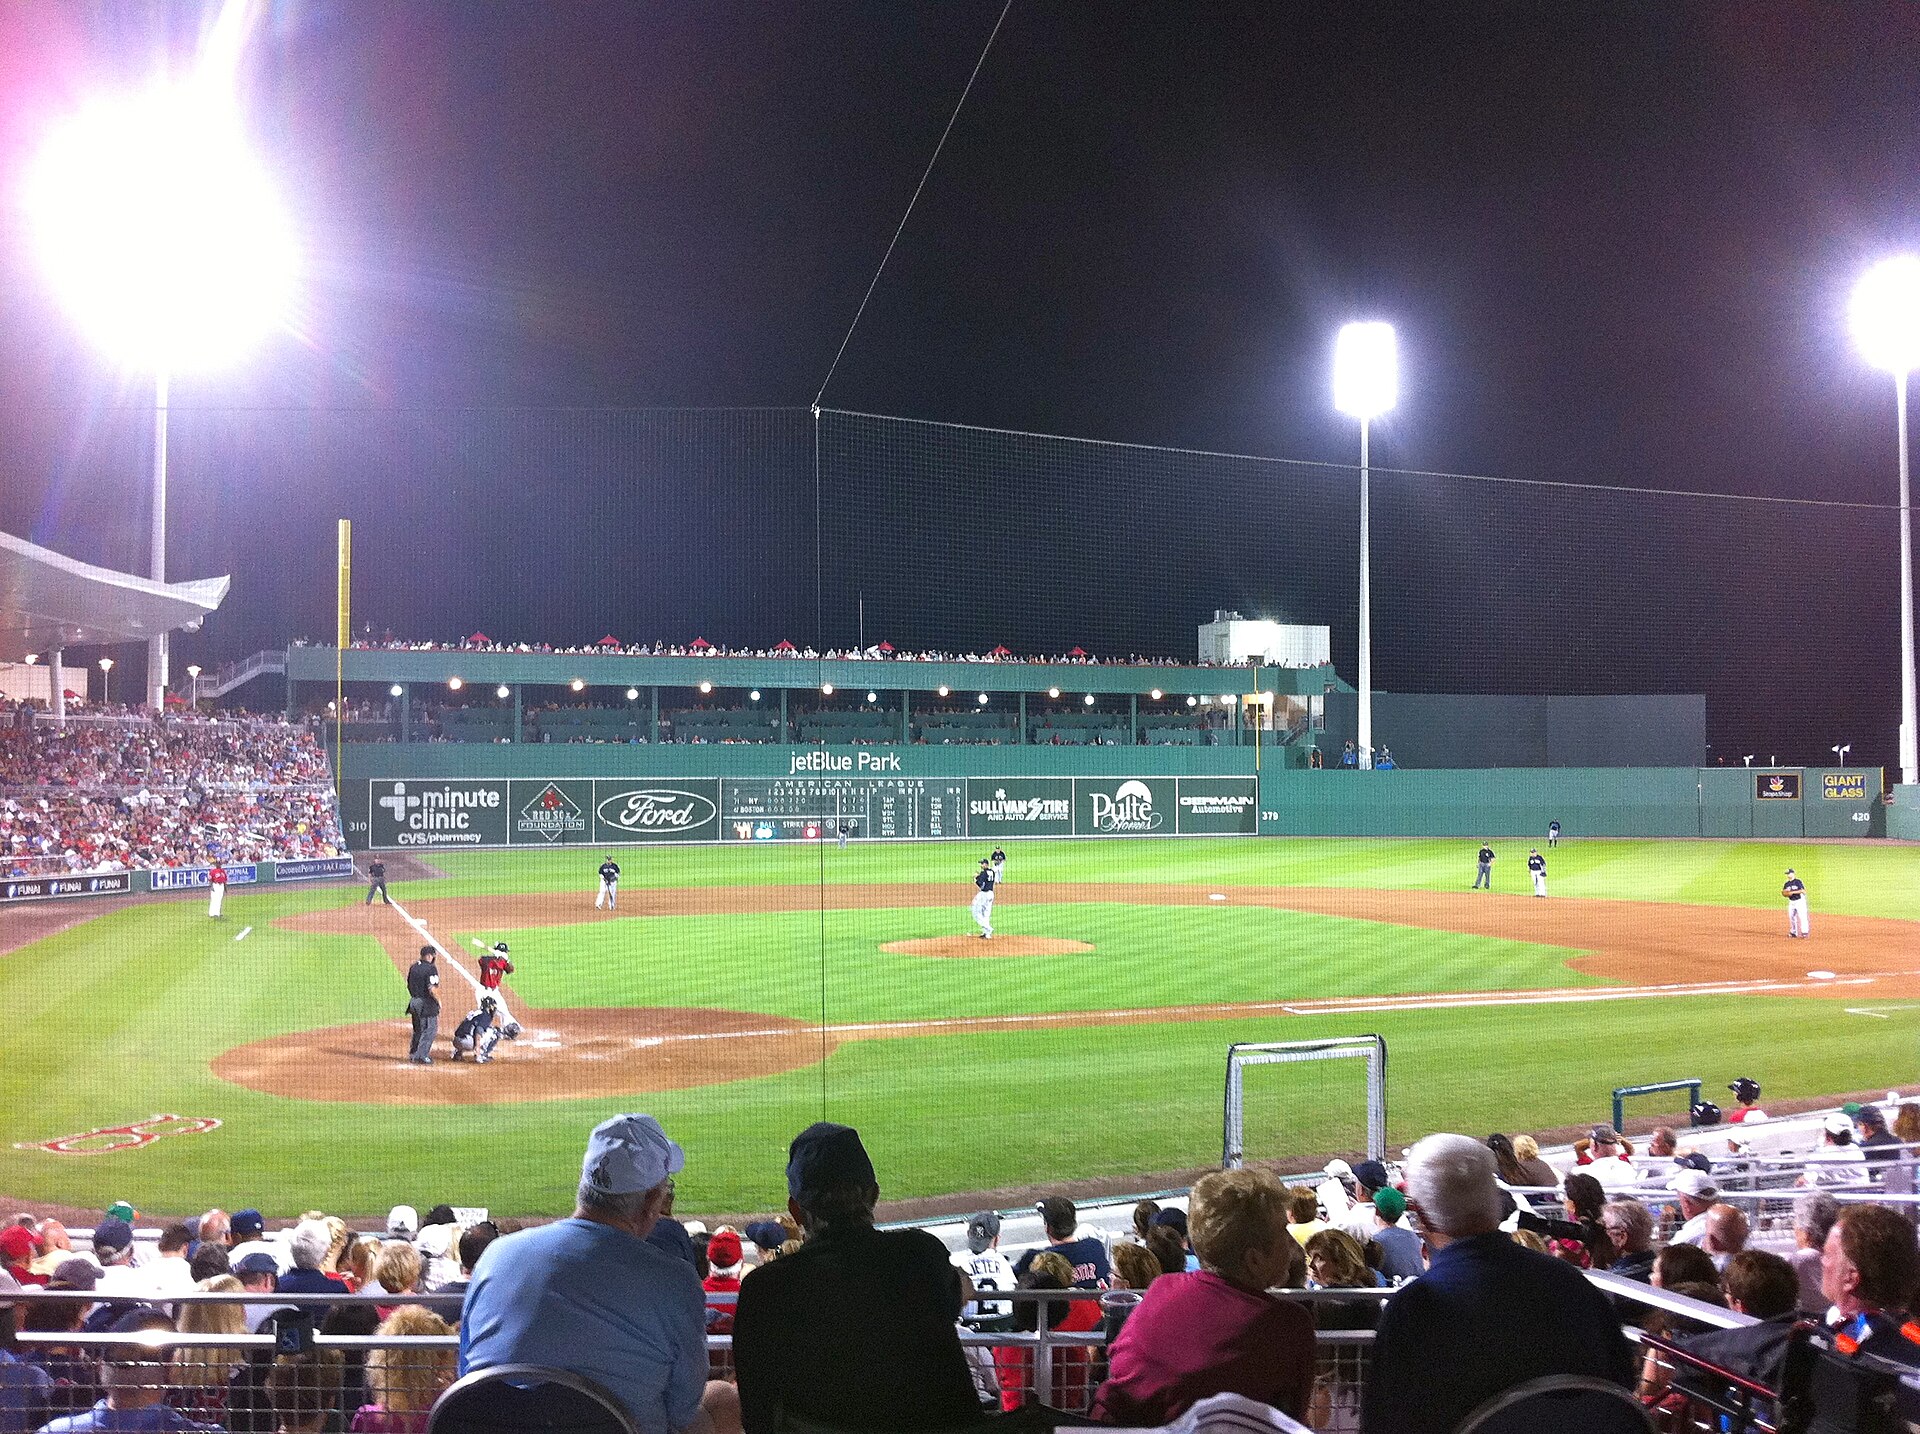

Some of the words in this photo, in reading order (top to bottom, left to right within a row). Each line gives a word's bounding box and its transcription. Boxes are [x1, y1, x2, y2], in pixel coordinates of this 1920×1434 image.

[790, 751, 852, 774] jetBlue
[858, 752, 901, 770] Park
[1824, 776, 1863, 786] GIANT
[422, 786, 500, 808] minute
[1824, 788, 1863, 798] GLASS
[1180, 796, 1254, 805] GERMAIN
[620, 795, 694, 826] Ford
[970, 800, 1027, 814] SULLIVAN
[1042, 800, 1069, 814] TIRE
[1089, 793, 1152, 827] Pulte
[1192, 805, 1243, 814] Automotive
[410, 808, 470, 830] clinic
[532, 810, 550, 820] RED
[1262, 812, 1278, 820] 379
[1852, 813, 1870, 821] 420
[349, 822, 366, 831] 310
[520, 822, 582, 830] FOUNDATION
[398, 832, 482, 844] CVS/pharmacy
[170, 872, 210, 886] LEHIG
[17, 885, 41, 895] FUNAI
[59, 882, 81, 892] FUNAI
[99, 879, 120, 889] FUNAI
